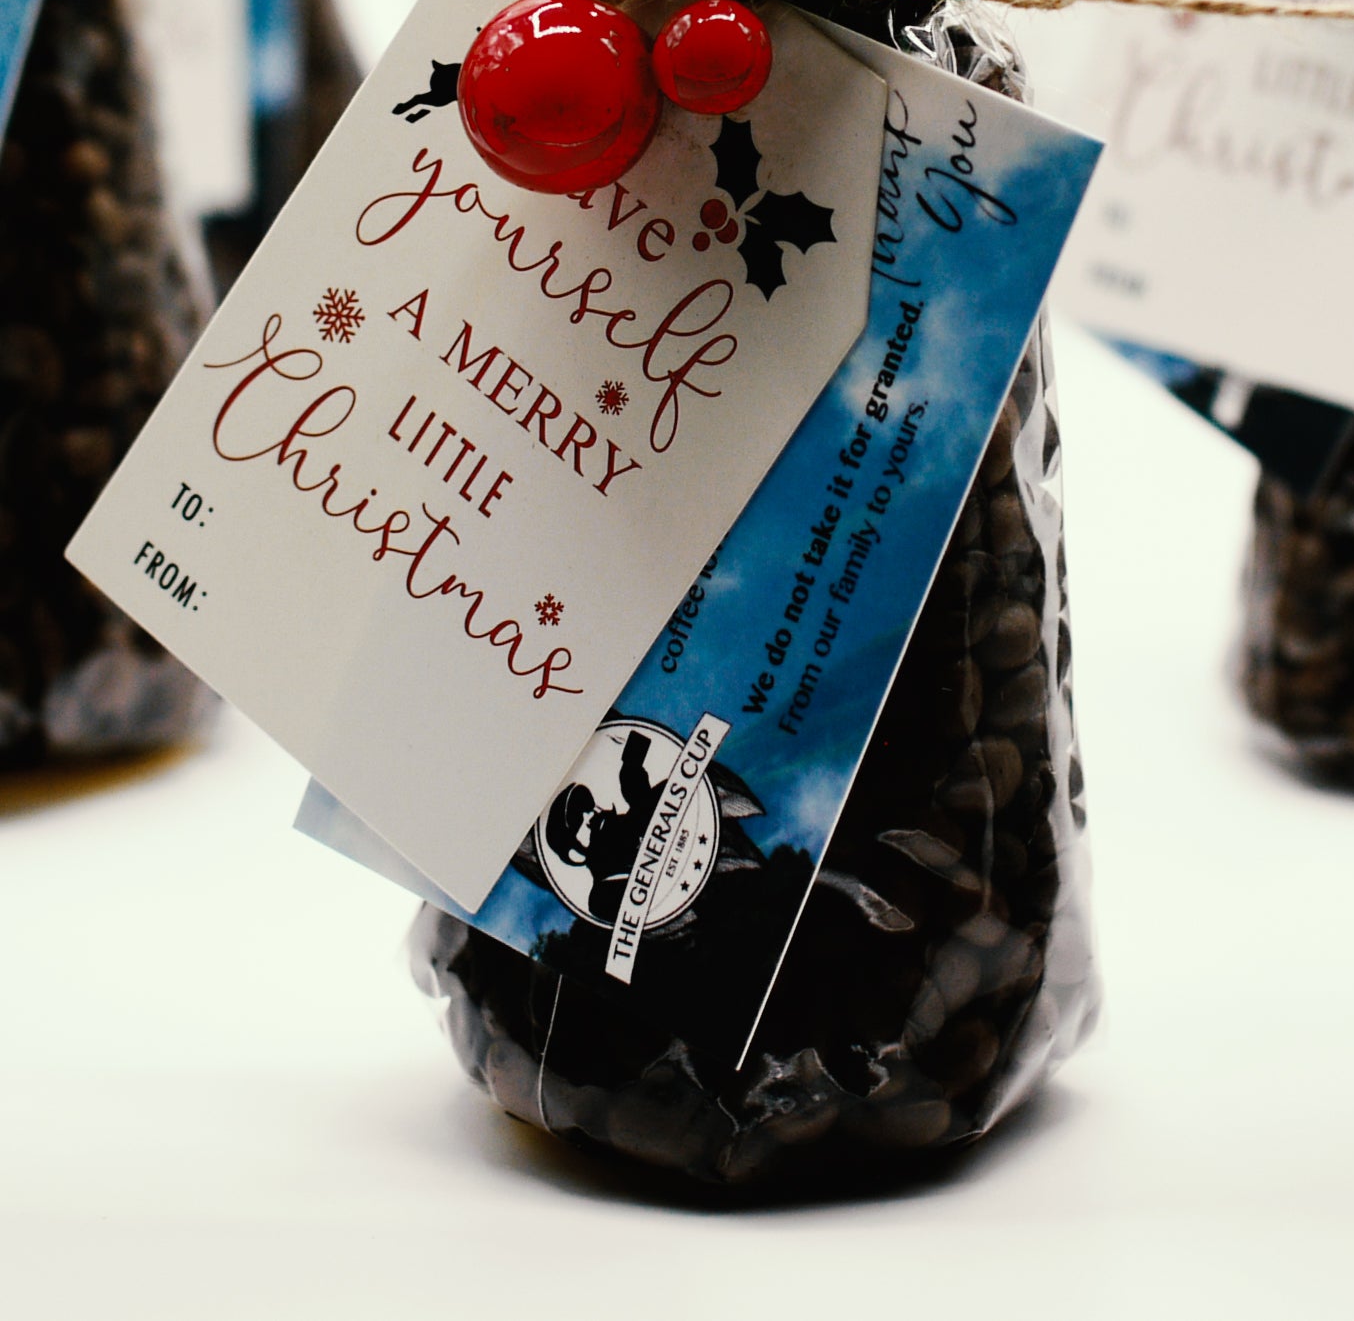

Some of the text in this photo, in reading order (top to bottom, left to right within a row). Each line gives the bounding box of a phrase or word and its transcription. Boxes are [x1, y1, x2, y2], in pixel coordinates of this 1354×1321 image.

[356, 147, 738, 453] yourself
[566, 181, 676, 262] ve
[387, 288, 643, 498] A MERRY
[388, 394, 514, 519] LITTLE
[133, 540, 208, 612] FROM:
[171, 482, 215, 528] TO:
[203, 313, 584, 700] Christmas
[741, 300, 925, 714] We do not take it for granted.
[778, 399, 930, 736] From our family to yours.
[661, 583, 706, 674] coffee
[612, 728, 713, 961] THE GENERALS CUP
